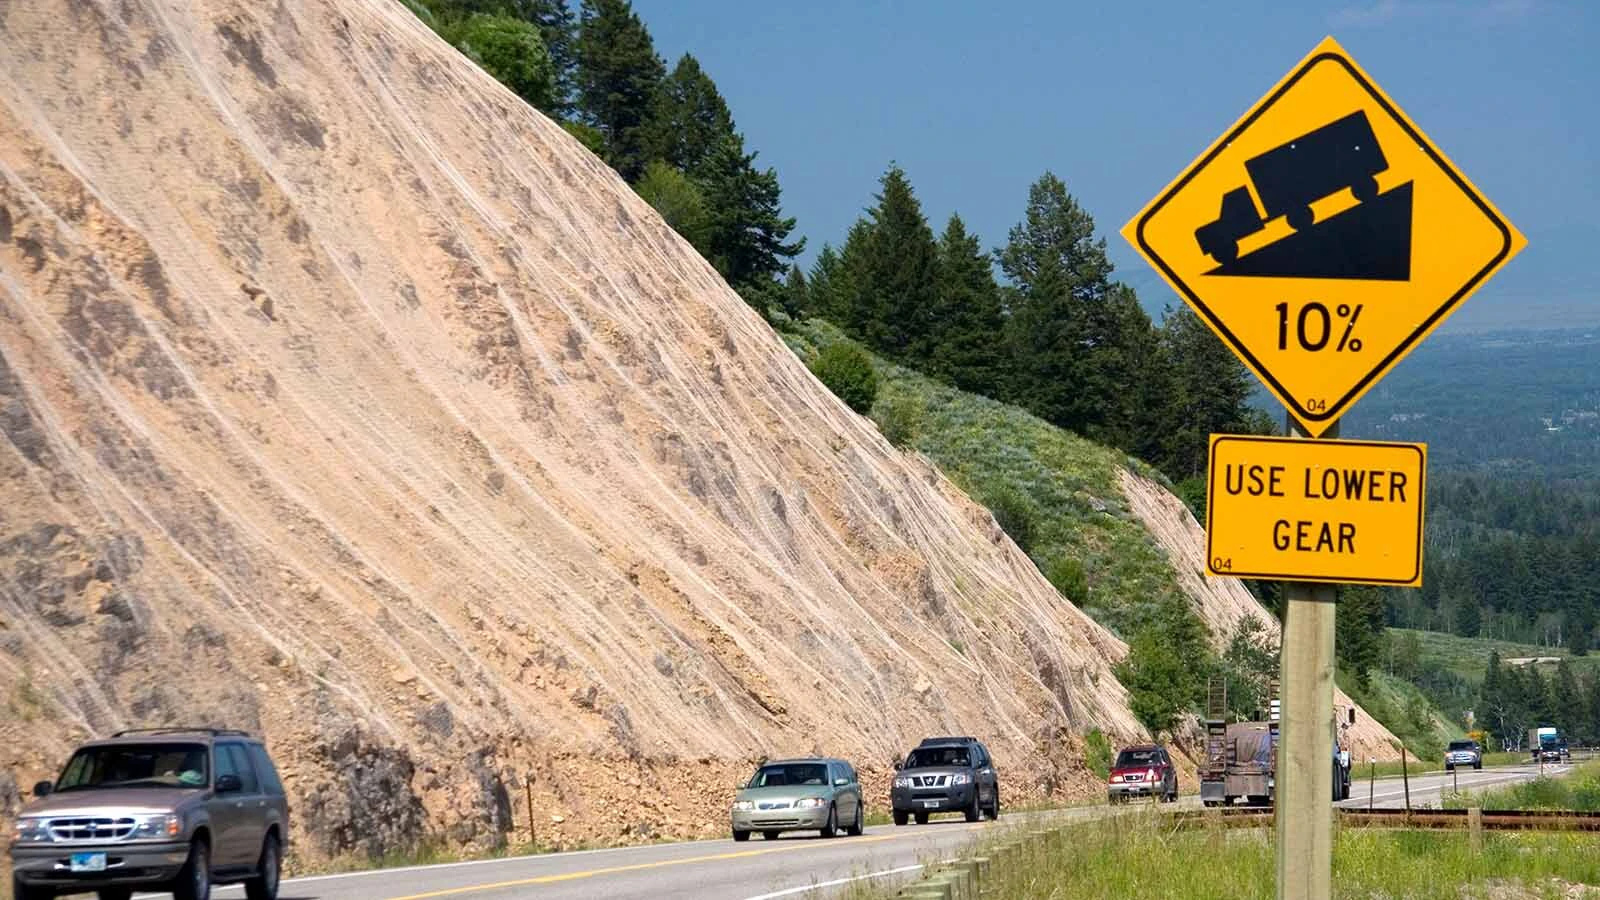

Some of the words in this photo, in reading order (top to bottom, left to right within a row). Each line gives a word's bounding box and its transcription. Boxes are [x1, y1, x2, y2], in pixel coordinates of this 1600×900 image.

[1275, 301, 1364, 353] 10%
[1306, 398, 1326, 412] 04
[1225, 464, 1285, 497] USE
[1304, 467, 1408, 503] LOWER
[1272, 519, 1357, 554] GEAR
[1213, 558, 1233, 571] 04
